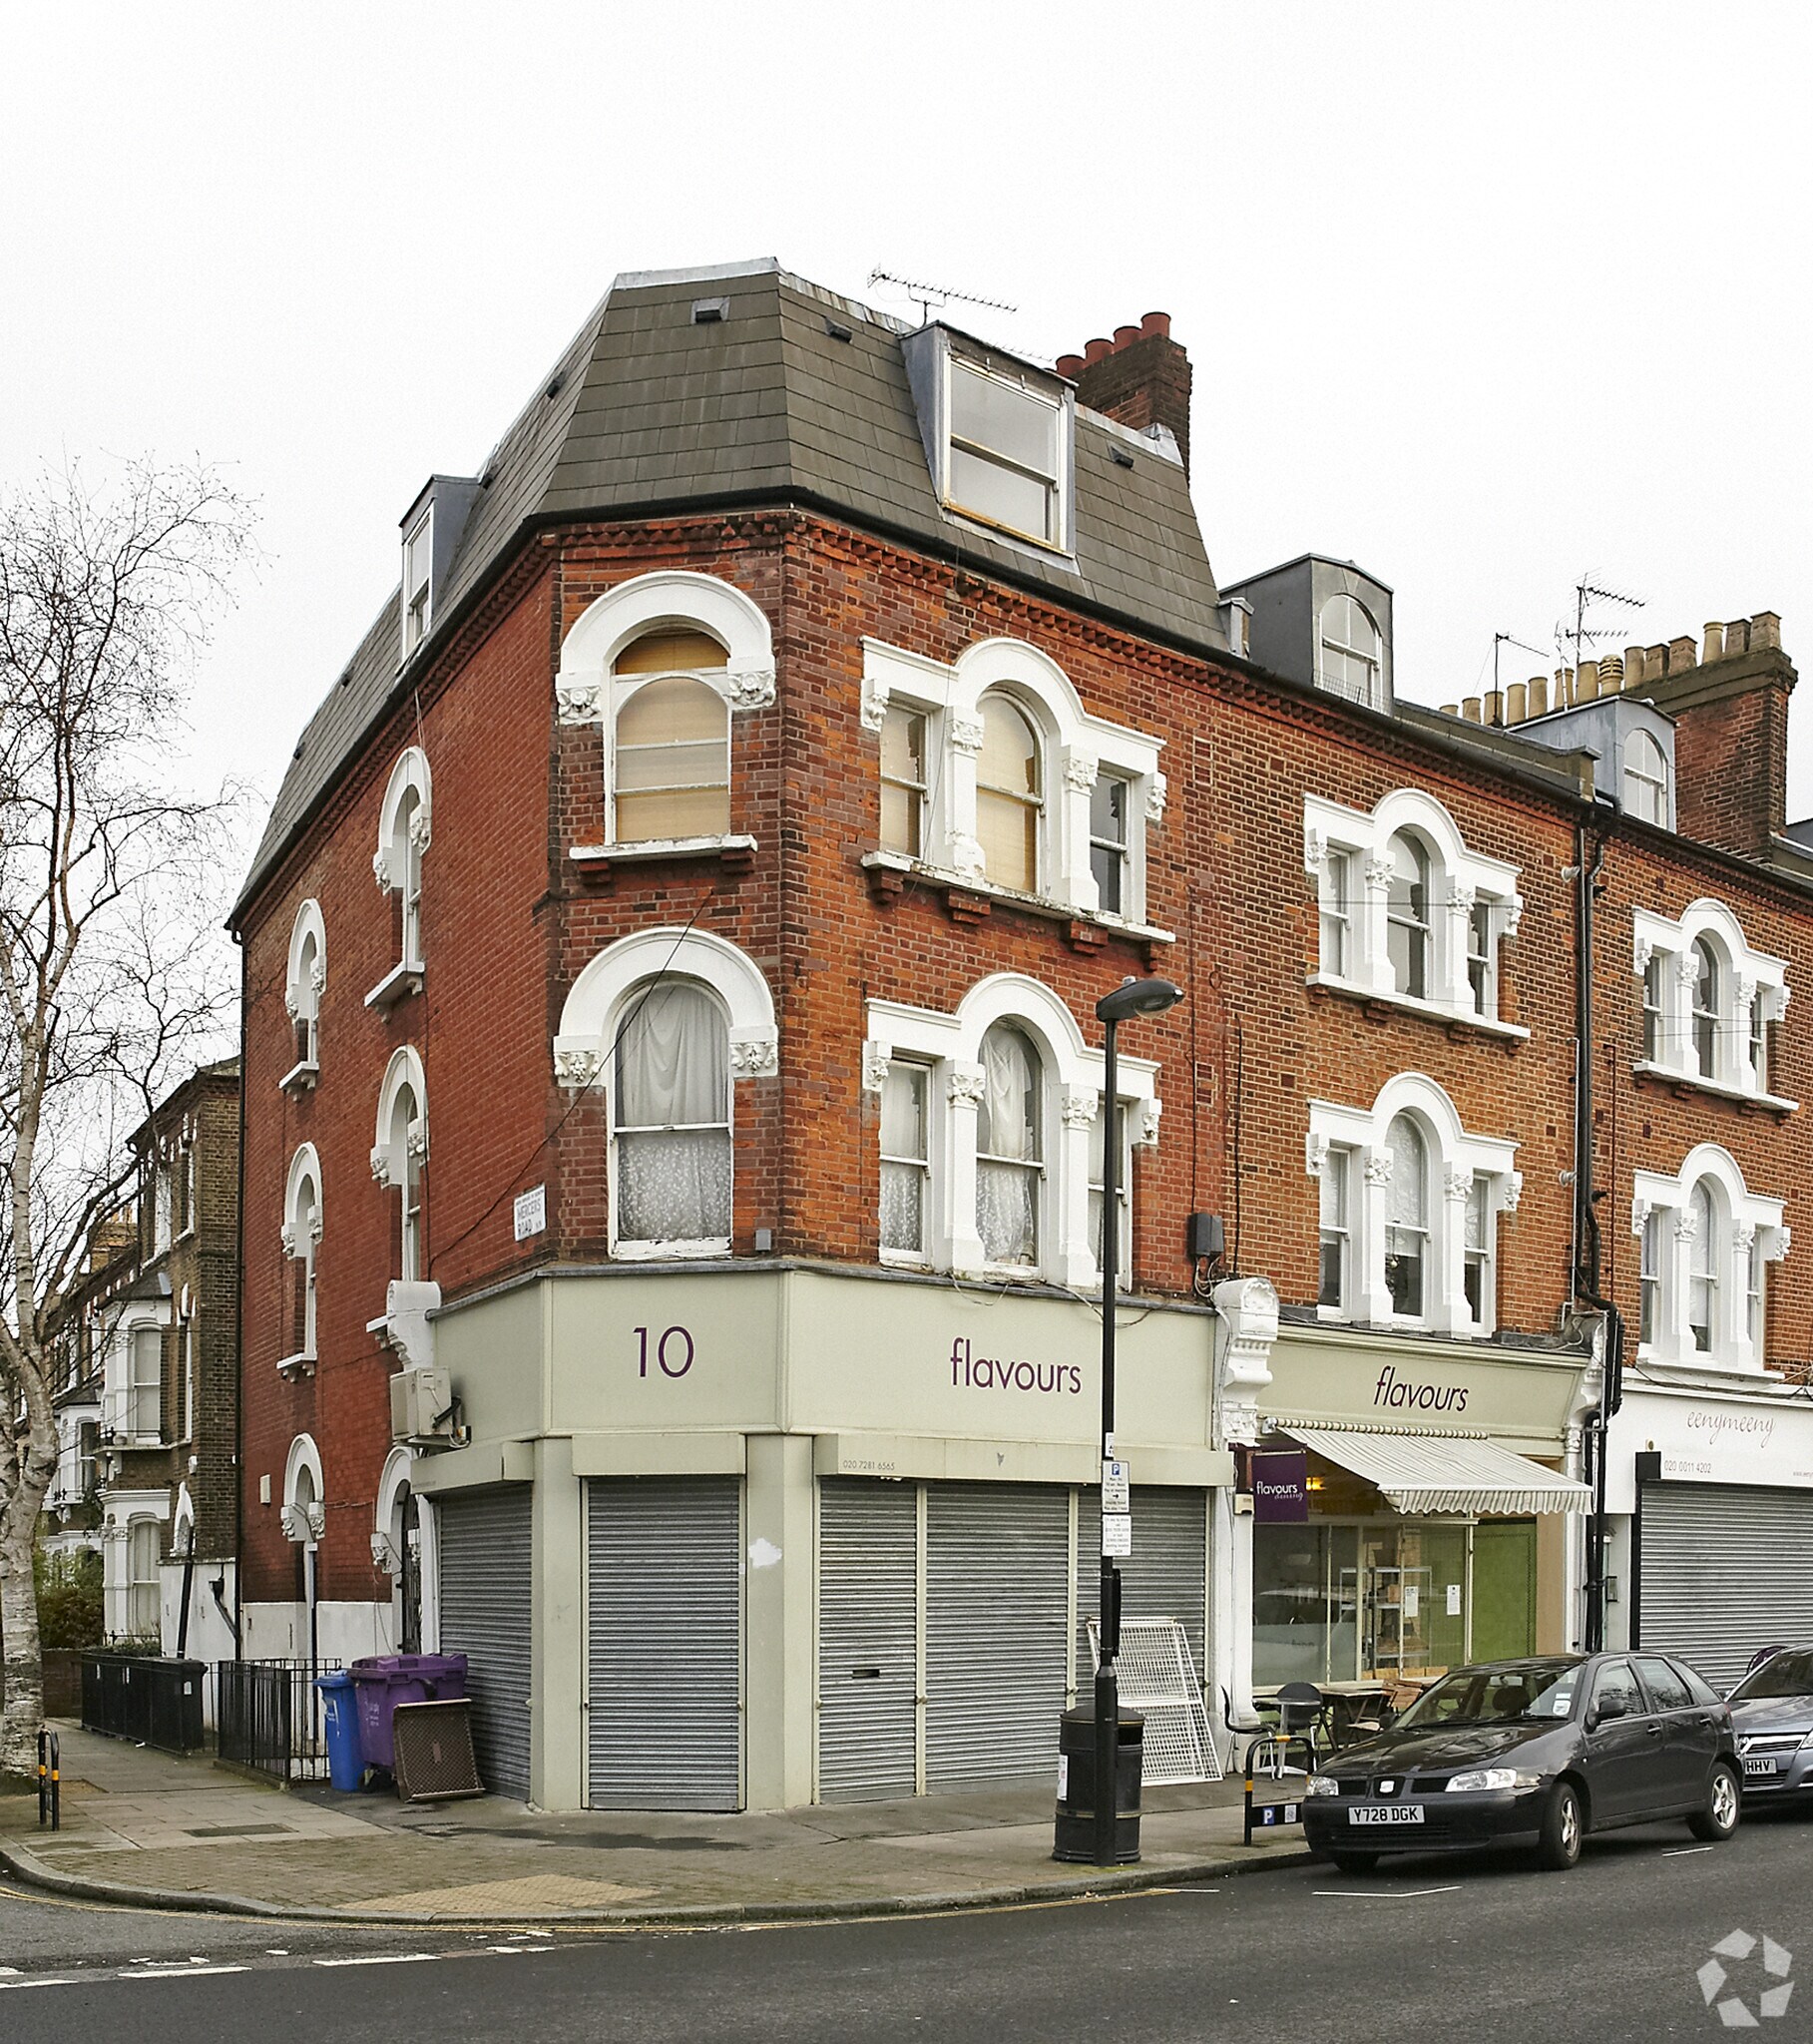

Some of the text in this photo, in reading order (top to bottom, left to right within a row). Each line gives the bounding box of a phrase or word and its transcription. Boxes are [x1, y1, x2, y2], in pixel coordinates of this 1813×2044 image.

[633, 1325, 694, 1378] 10
[950, 1337, 1081, 1394] flavours
[1374, 1365, 1469, 1411] flavours
[1687, 1411, 1775, 1448] eenymeeny
[843, 1460, 857, 1469] 020
[1664, 1459, 1676, 1471] 020
[1256, 1480, 1298, 1495] flavours
[1746, 1760, 1770, 1773] HHV
[1263, 1809, 1273, 1824] P
[1353, 1806, 1418, 1822] Y728 DGK
